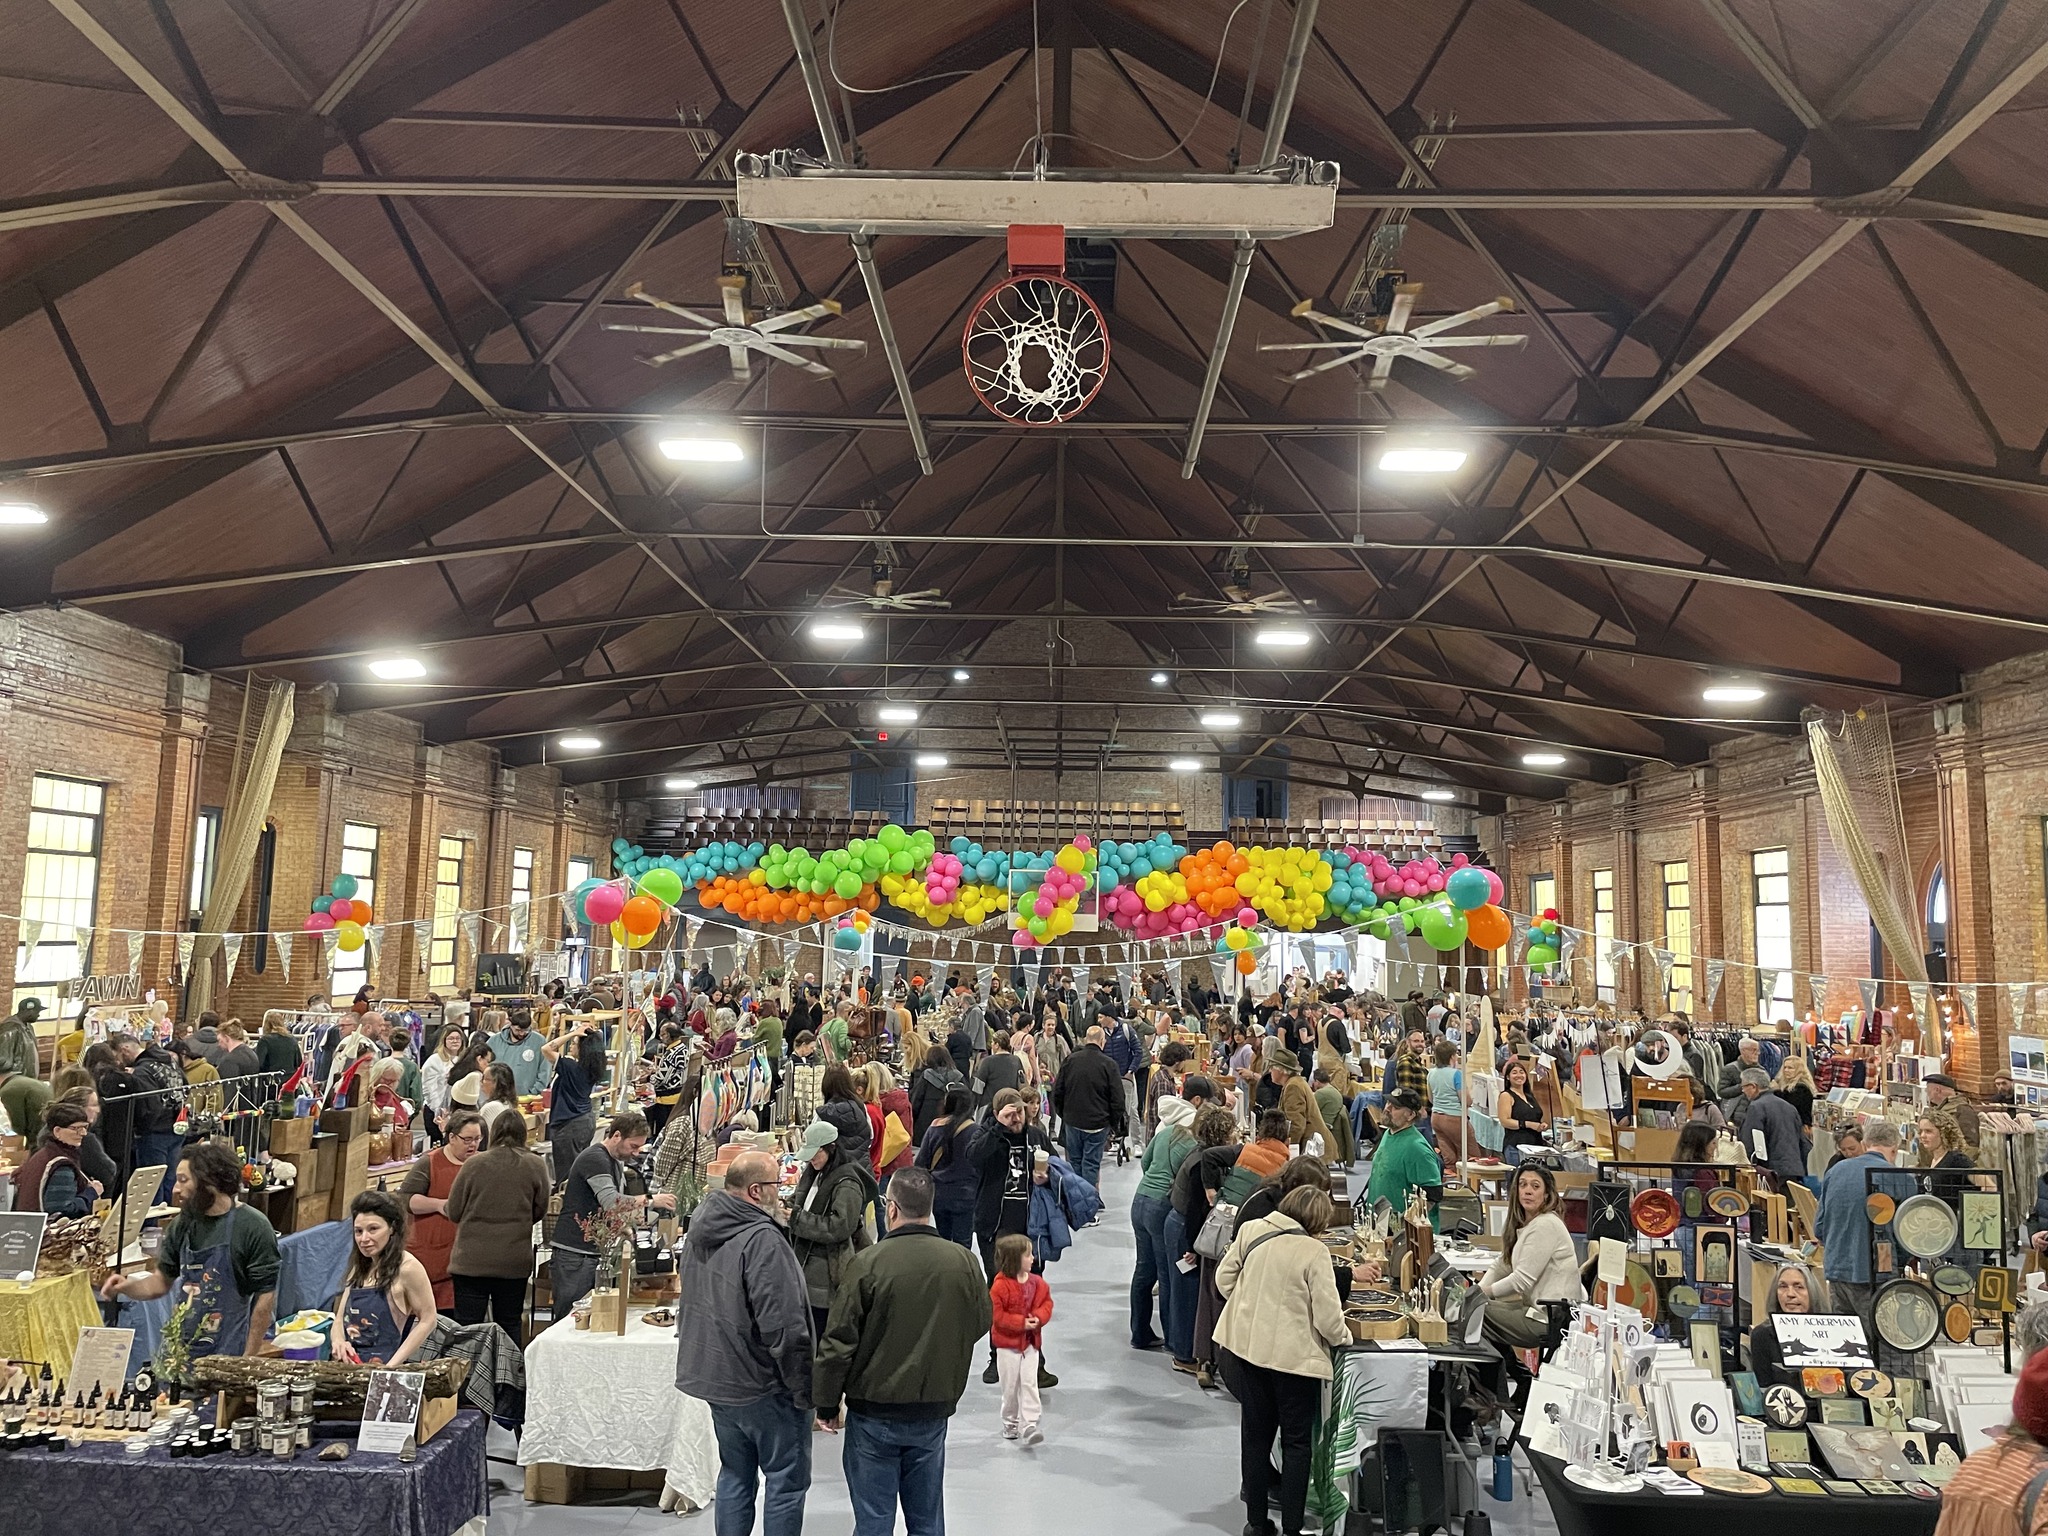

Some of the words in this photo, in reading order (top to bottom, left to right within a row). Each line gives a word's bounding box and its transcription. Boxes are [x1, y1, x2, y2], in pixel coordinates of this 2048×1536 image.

[67, 973, 141, 1003] FAWN
[1778, 1317, 1800, 1326] AMY
[1803, 1317, 1857, 1327] ACKERMAN
[1811, 1330, 1829, 1339] ART
